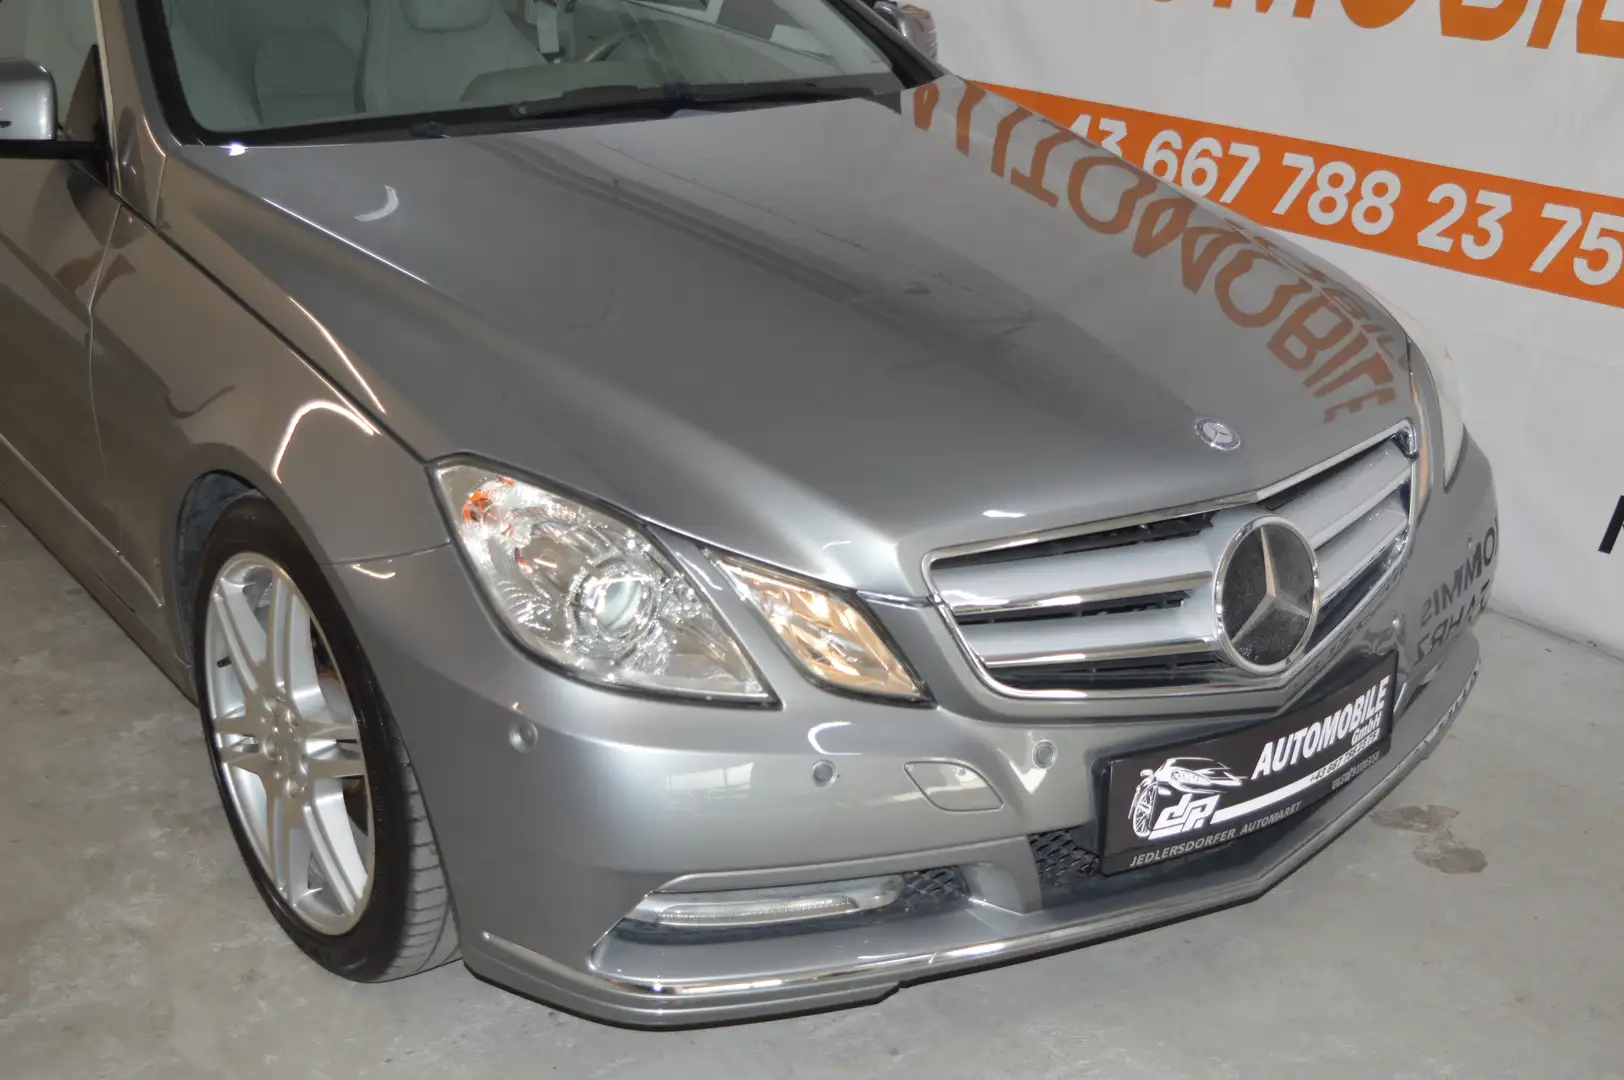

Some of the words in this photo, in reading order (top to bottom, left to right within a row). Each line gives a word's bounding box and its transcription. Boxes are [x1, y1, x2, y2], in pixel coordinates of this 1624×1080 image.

[1143, 129, 1260, 204] 667
[1272, 152, 1400, 235] 788
[1417, 183, 1512, 260] 23
[1529, 202, 1624, 286] 75
[1250, 675, 1389, 780] AUTOMOBILE
[1351, 710, 1382, 746] GmbH
[1130, 828, 1236, 867] JEDLERSDORFER
[1240, 801, 1302, 835] AUTOMARKT
